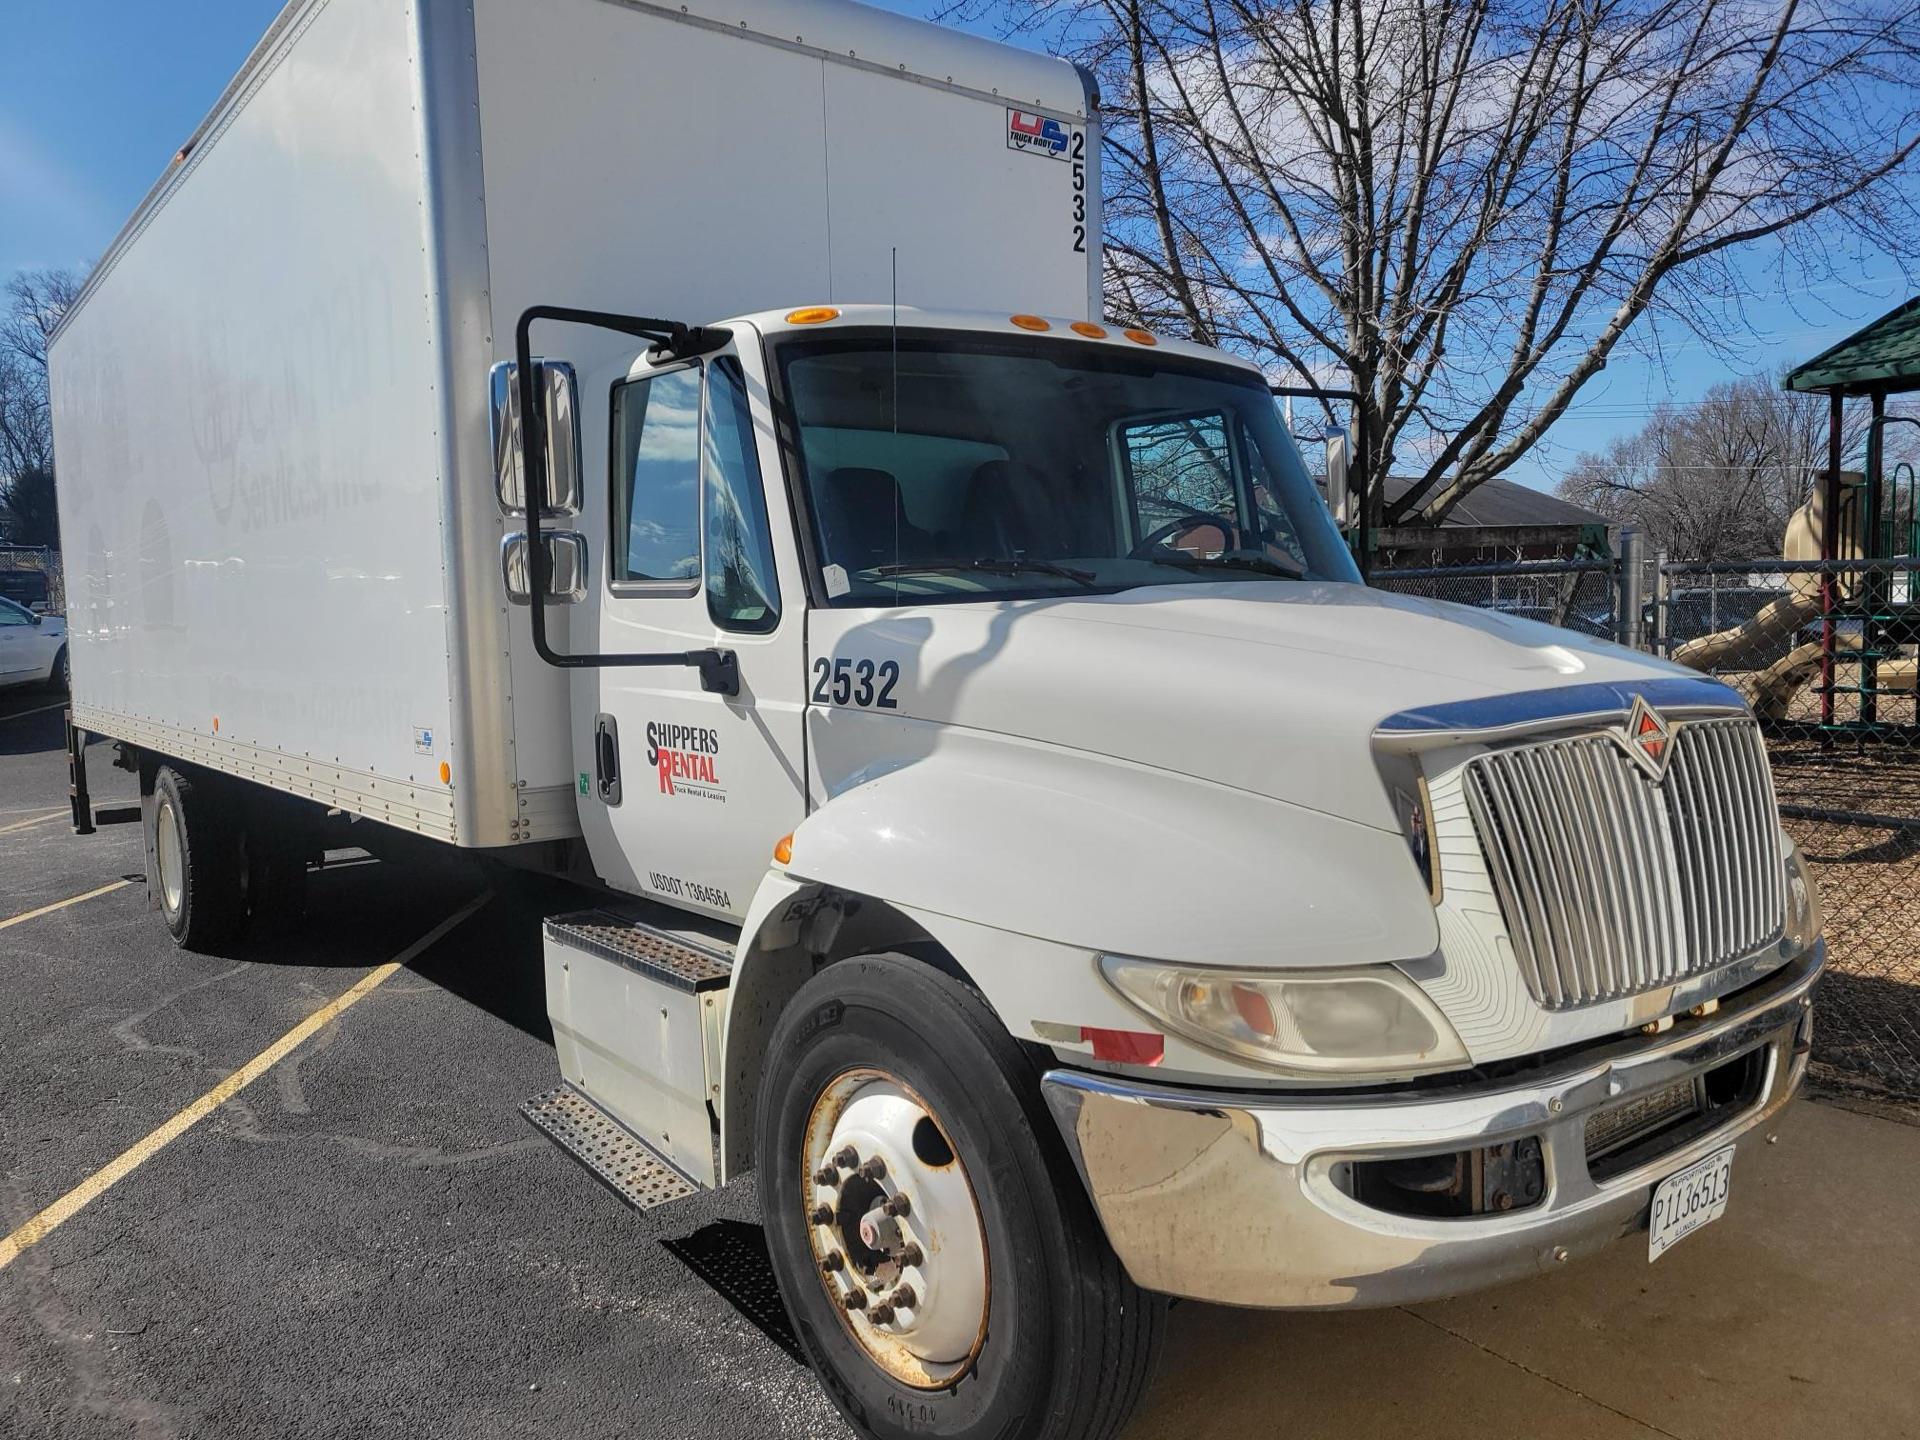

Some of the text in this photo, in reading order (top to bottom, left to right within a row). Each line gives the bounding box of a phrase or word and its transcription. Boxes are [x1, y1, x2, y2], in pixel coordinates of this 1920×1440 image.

[1010, 131, 1052, 149] TRUCK BODY
[1072, 131, 1086, 253] 2532
[812, 657, 900, 709] 2532
[647, 721, 719, 766] SHIPPERS
[658, 748, 720, 796] RENTAL
[674, 785, 726, 803] Truck Rental & Leasing
[649, 871, 731, 910] USDOT 1364564
[1653, 1163, 1730, 1237] P1136513
